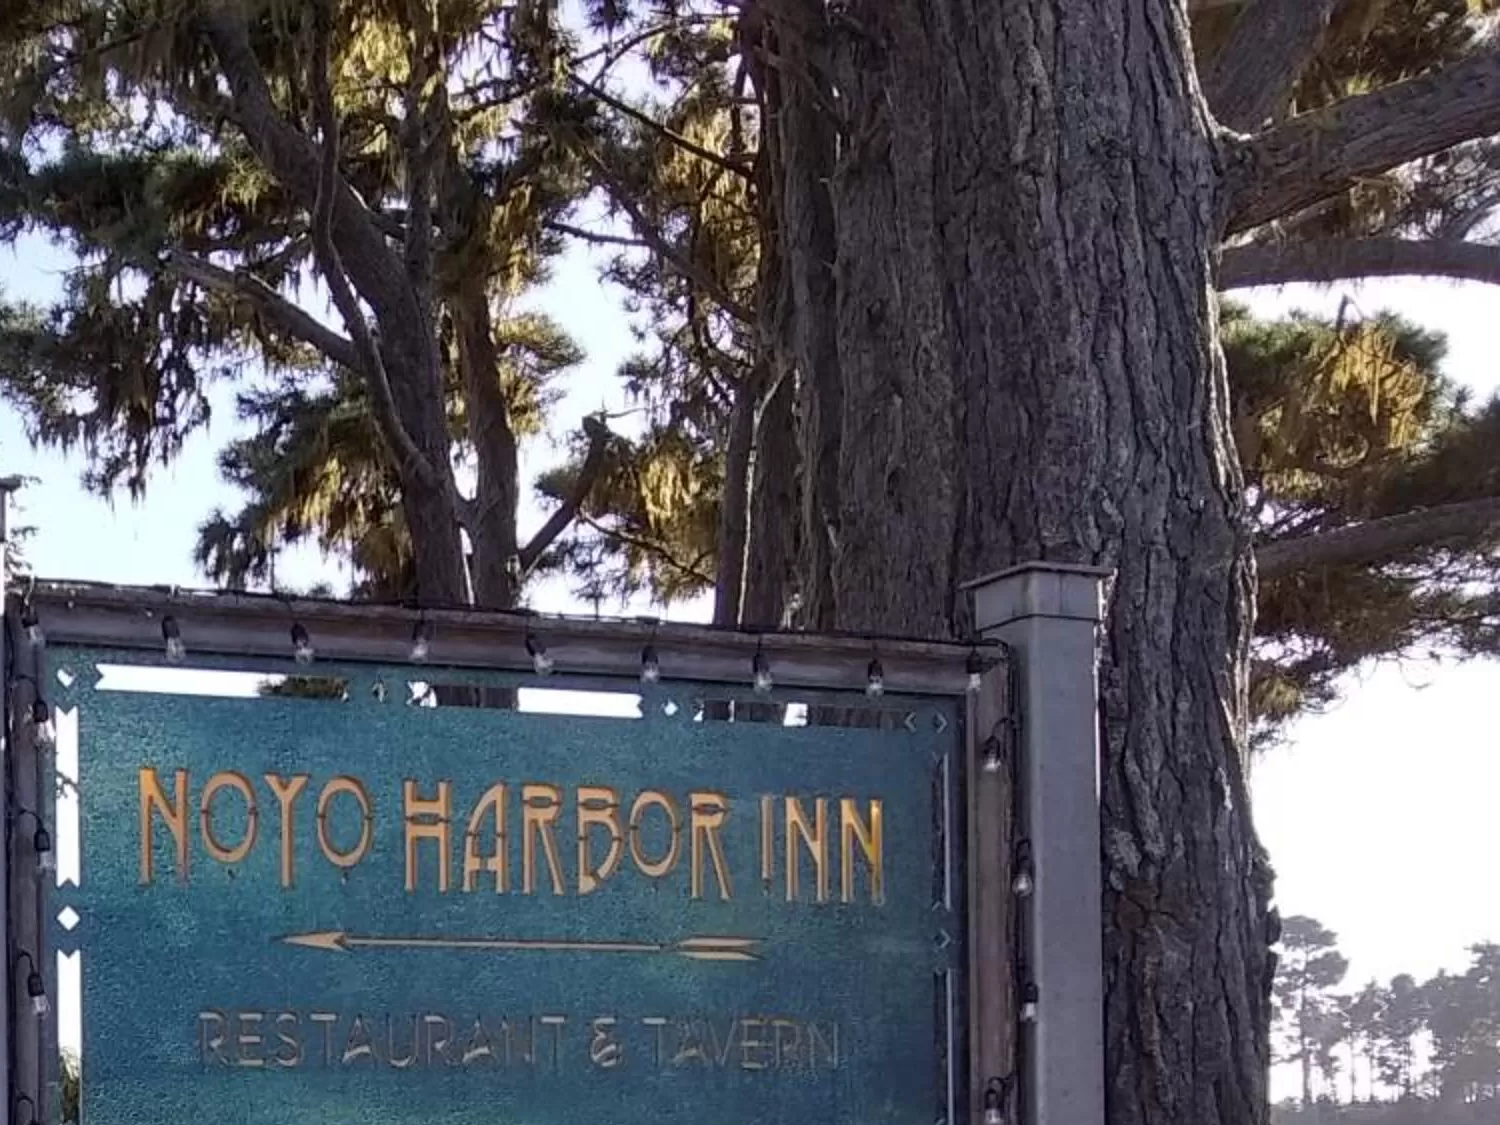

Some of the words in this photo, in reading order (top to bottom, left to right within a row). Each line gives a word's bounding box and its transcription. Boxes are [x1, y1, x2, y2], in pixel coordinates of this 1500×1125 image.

[138, 767, 373, 887] NOYO
[403, 780, 733, 900] HARBOR
[761, 794, 884, 904] INN
[198, 1011, 567, 1069] RESTAURANT
[590, 1015, 625, 1069] &
[642, 1015, 842, 1071] TAVERN
